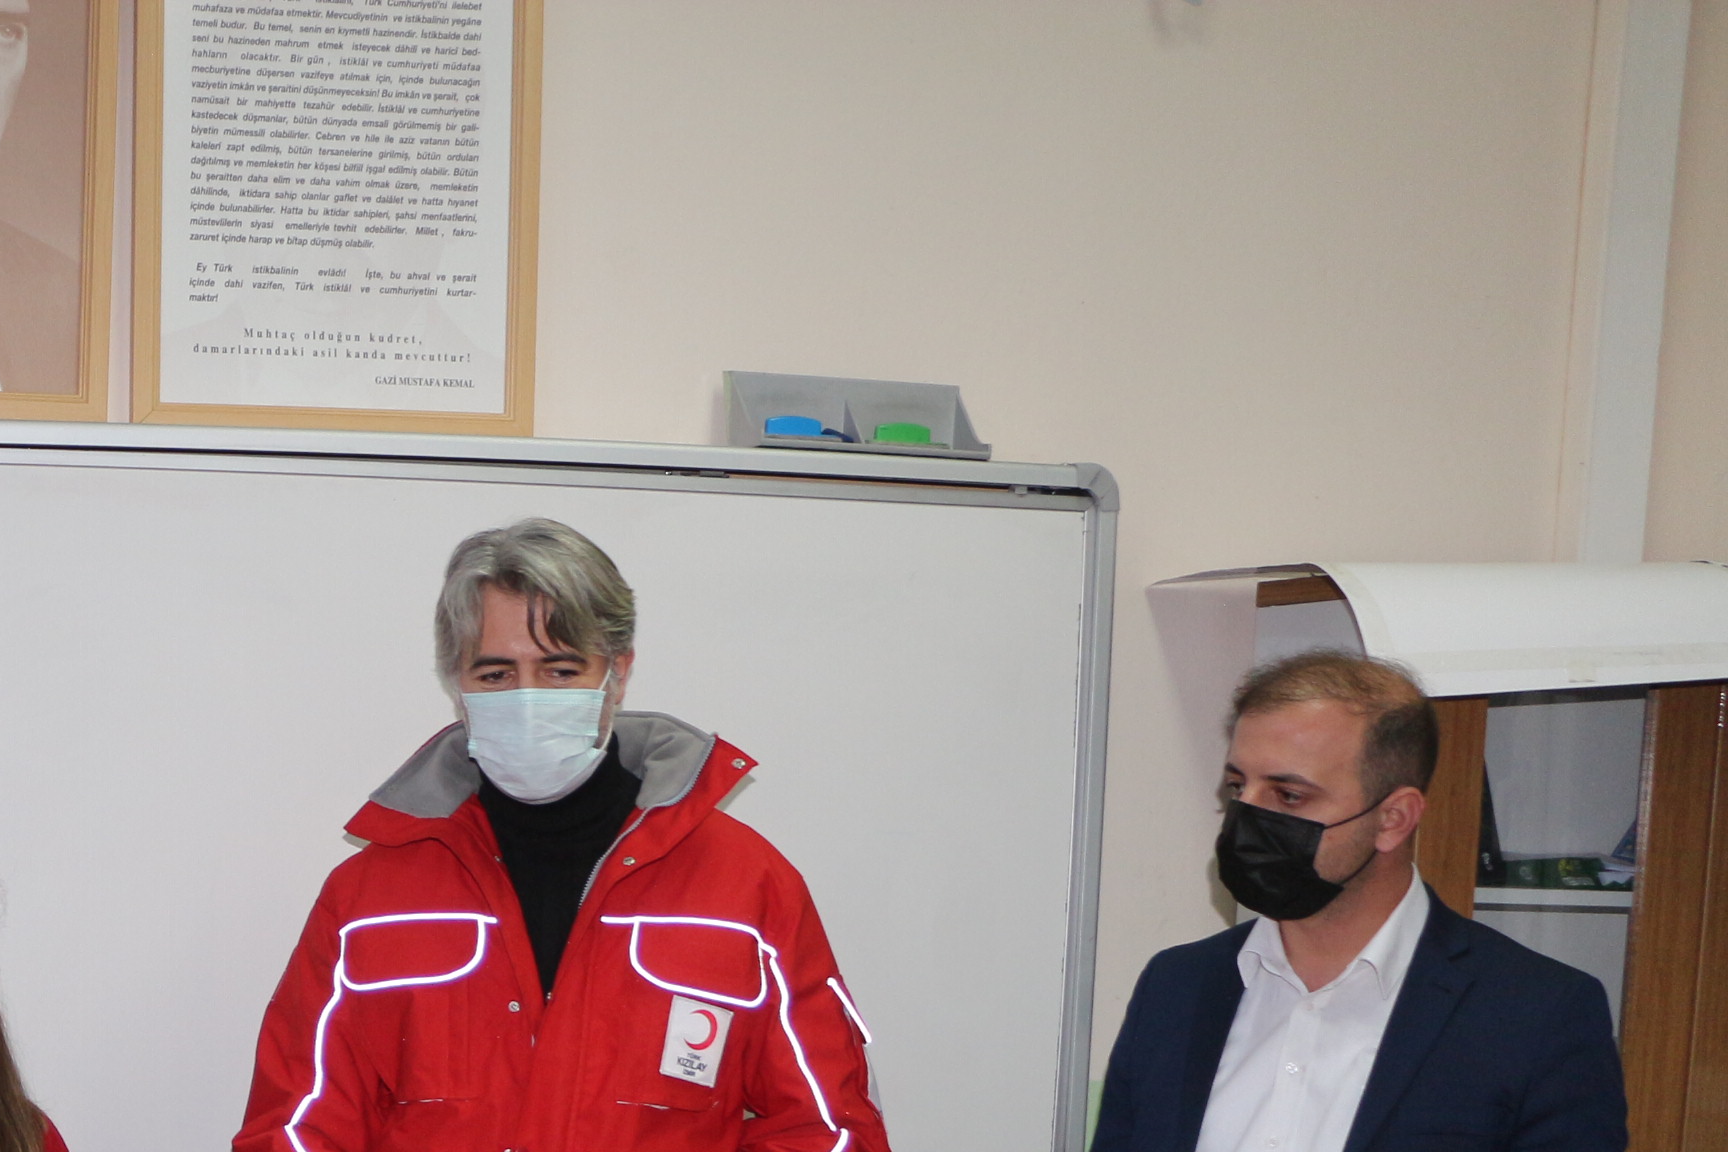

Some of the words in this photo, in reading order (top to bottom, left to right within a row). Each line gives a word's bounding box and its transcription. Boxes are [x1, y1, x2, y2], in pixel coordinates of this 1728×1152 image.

[196, 262, 208, 273] Ey
[214, 263, 233, 272] Türk
[252, 266, 299, 275] istikbalinin
[389, 271, 402, 280] bu
[407, 272, 431, 280] ahval
[452, 274, 477, 283] şerait
[189, 278, 216, 288] içinde
[224, 279, 244, 288] dahi
[295, 282, 314, 291] Türk
[379, 287, 438, 296] cumhuriyetini
[446, 288, 477, 297] kurtar-
[244, 328, 295, 341] Muhtaç
[304, 331, 360, 343] olduğun
[193, 345, 304, 356] damarlarındaki
[312, 348, 337, 357] asil
[346, 349, 386, 359] kanda
[399, 377, 441, 387] MUSTAFA
[443, 379, 475, 388] KEMAL
